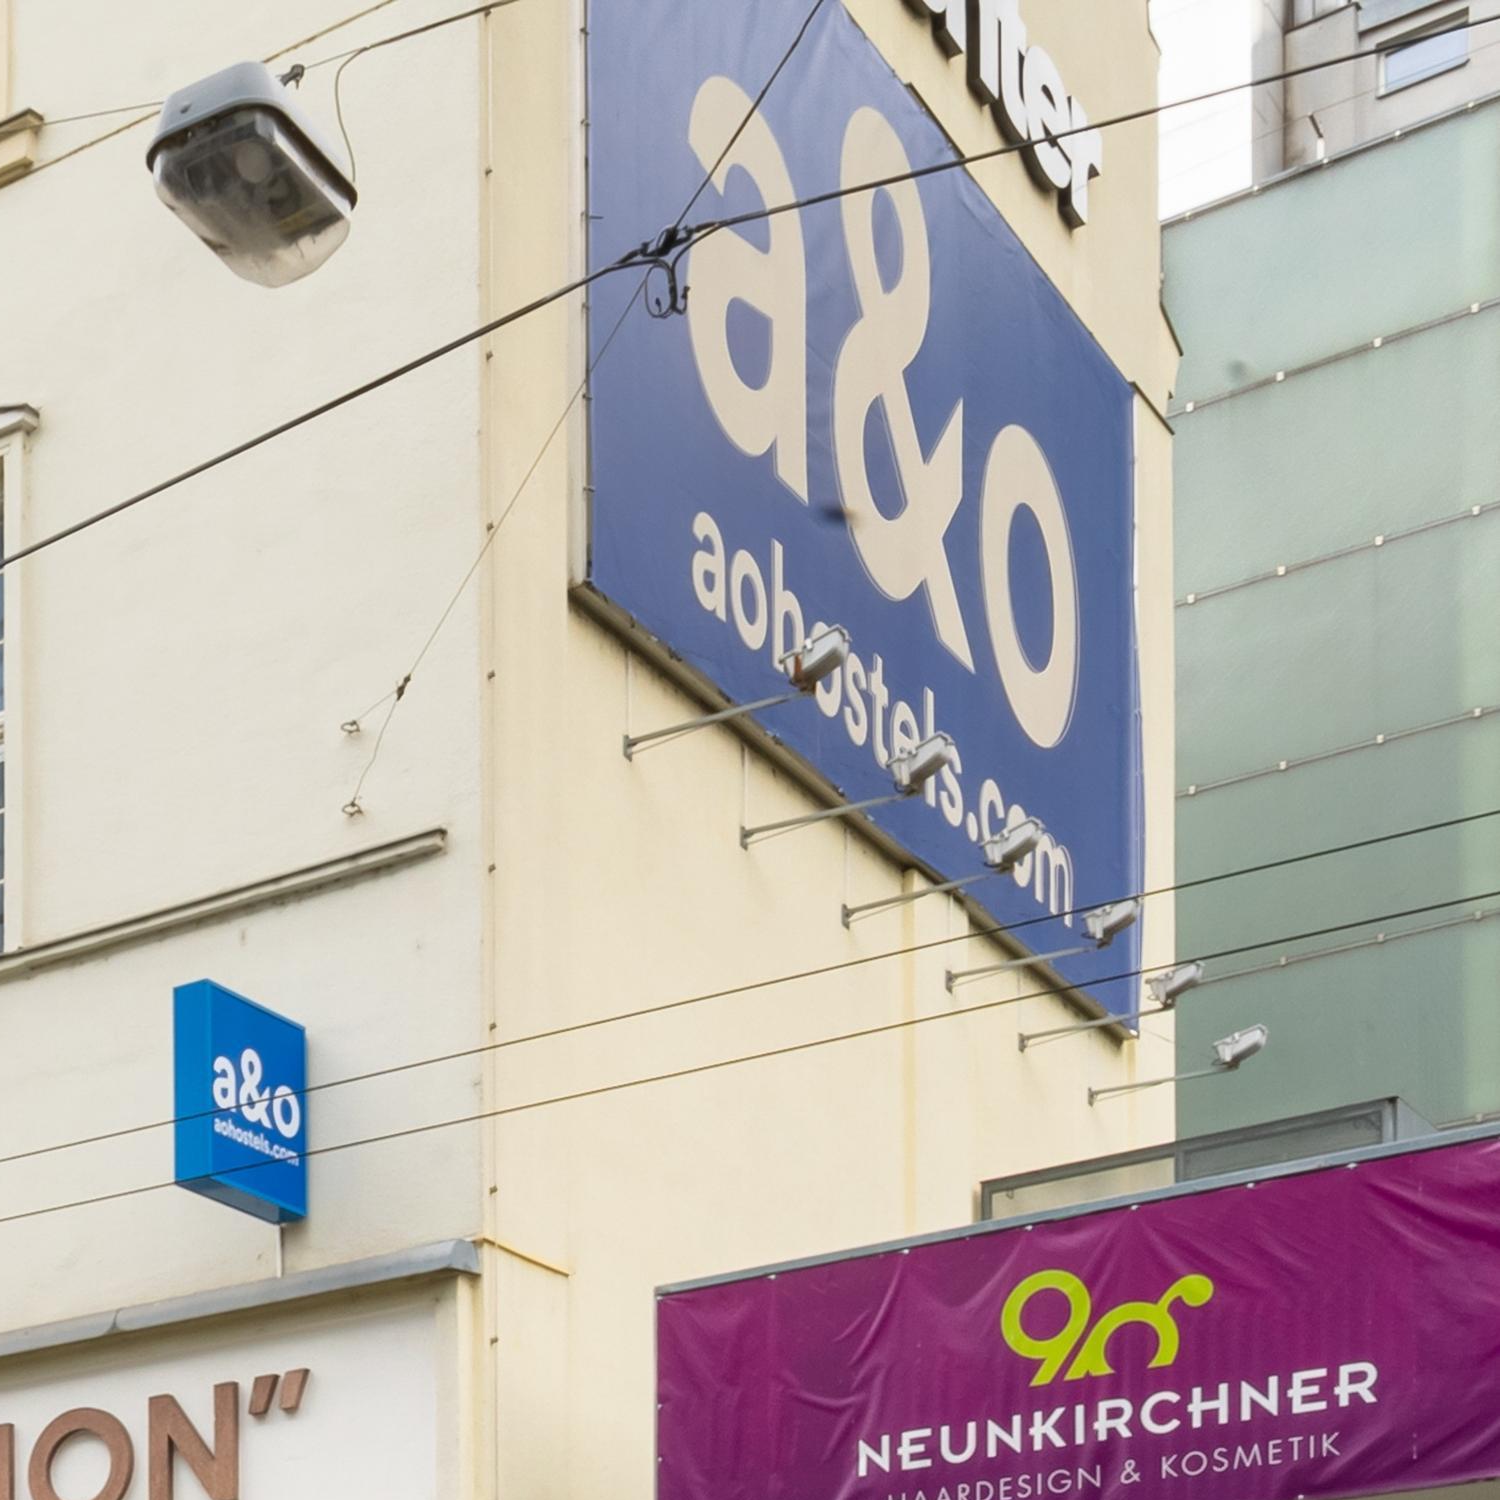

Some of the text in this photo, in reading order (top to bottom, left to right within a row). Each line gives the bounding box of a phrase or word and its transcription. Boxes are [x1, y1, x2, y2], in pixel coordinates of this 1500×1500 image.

[687, 75, 1080, 749] a&o
[212, 1048, 300, 1139] a&o
[856, 1361, 1379, 1478] NEUNKIRCHNER
[1119, 1458, 1142, 1484] &
[1160, 1431, 1342, 1479] KOSMETIK
